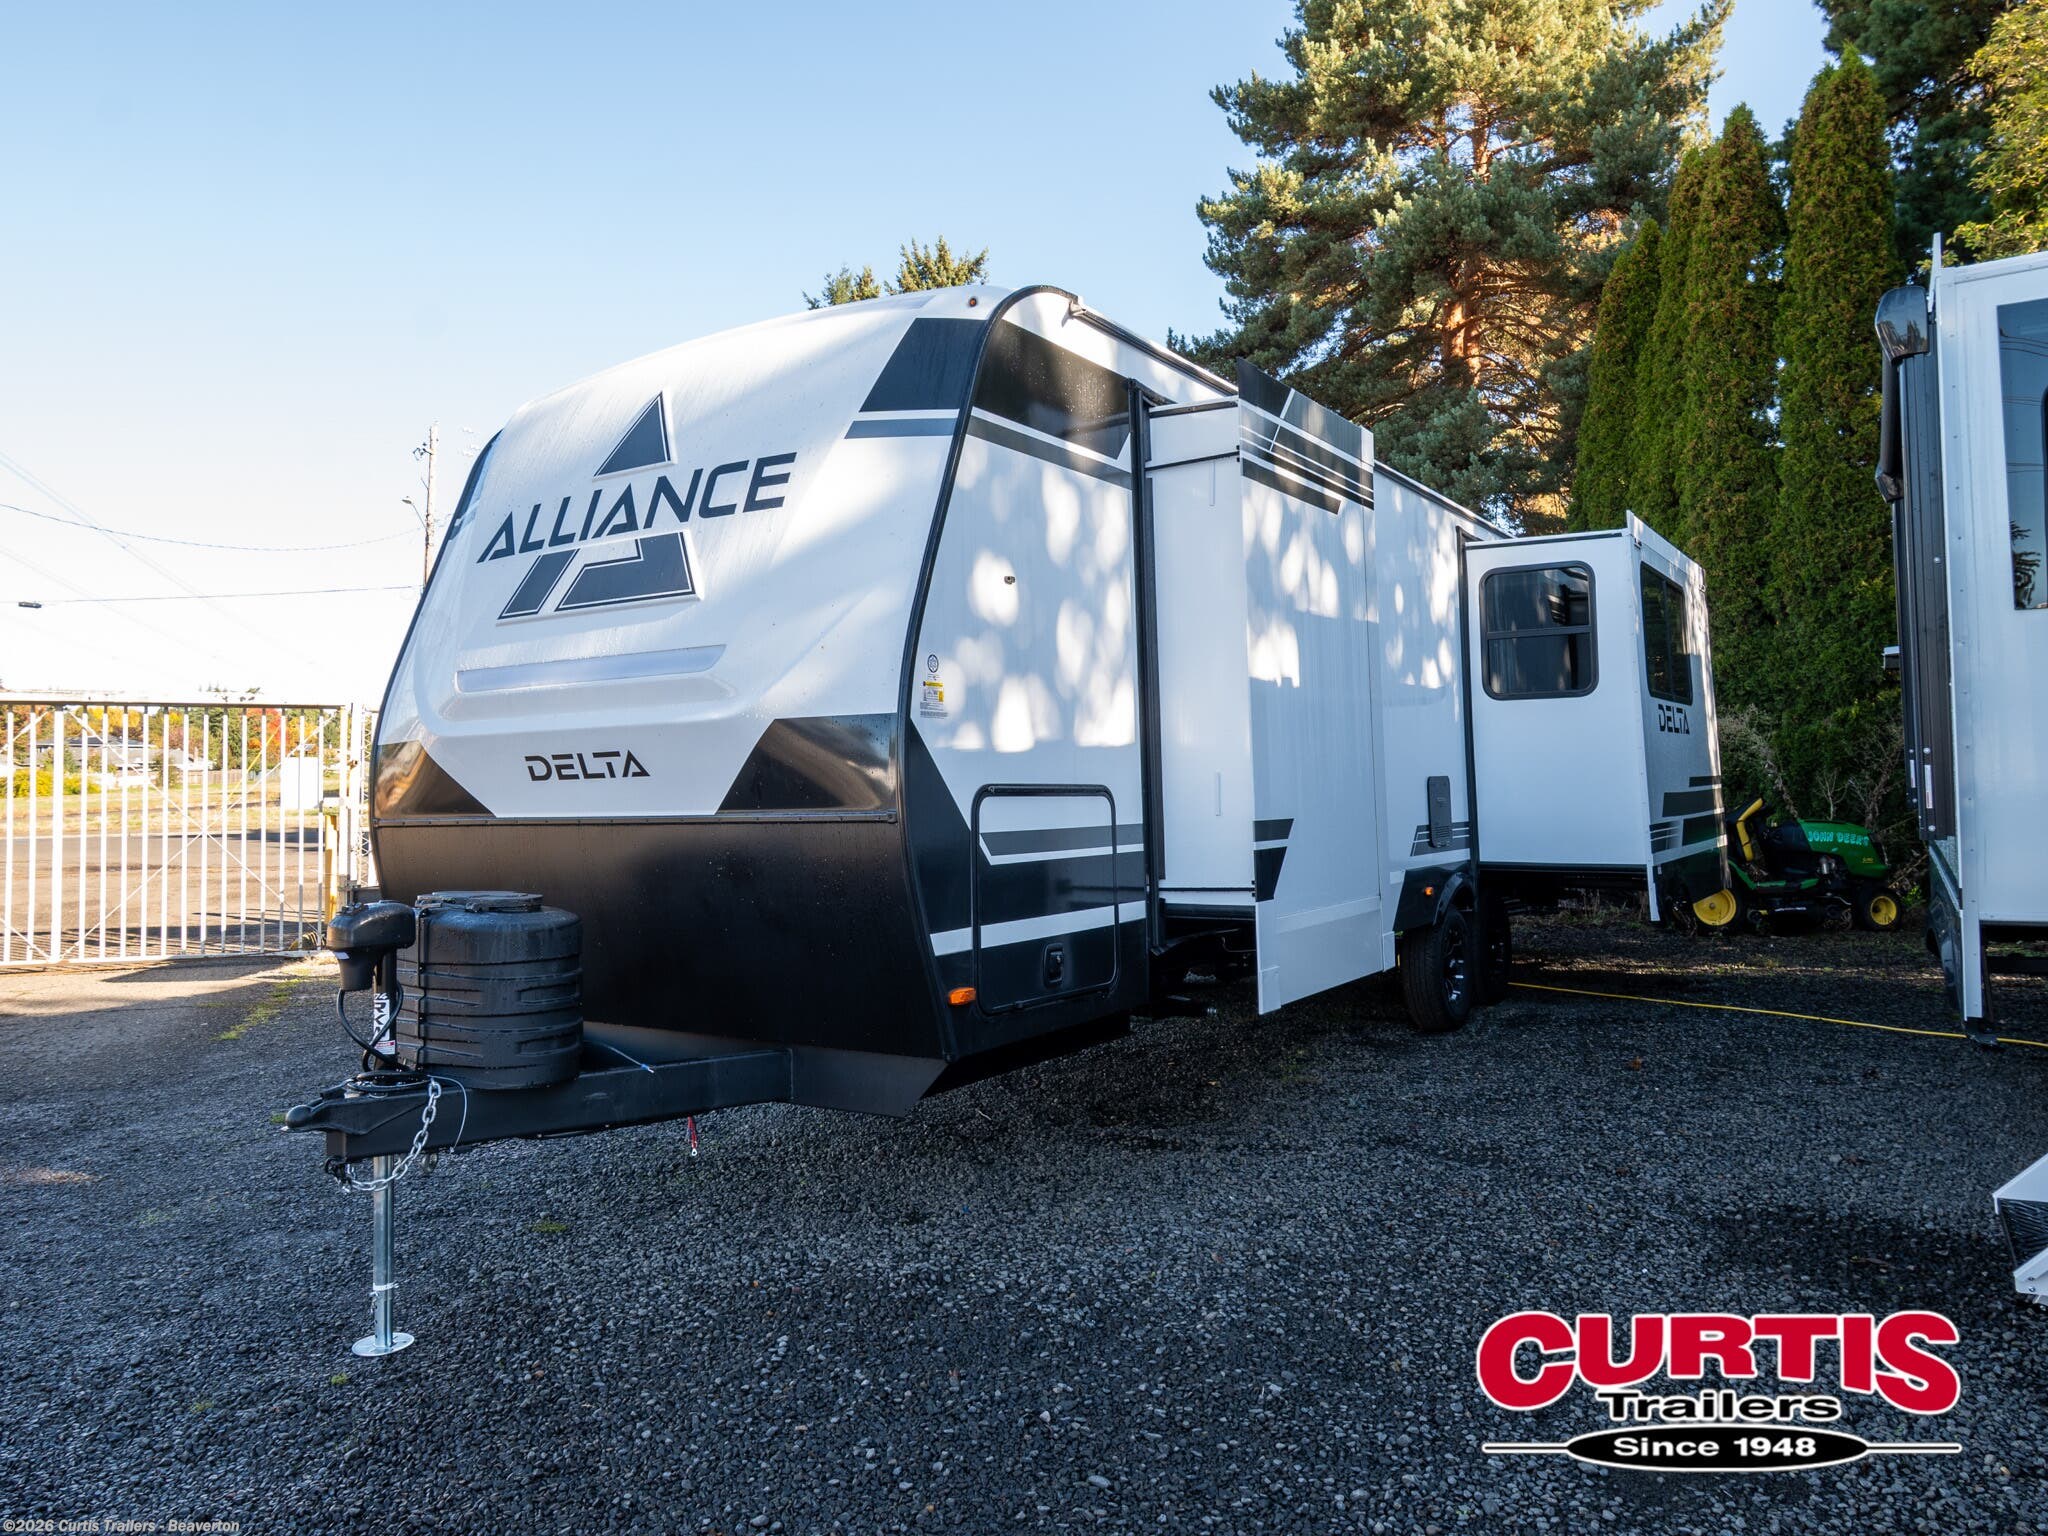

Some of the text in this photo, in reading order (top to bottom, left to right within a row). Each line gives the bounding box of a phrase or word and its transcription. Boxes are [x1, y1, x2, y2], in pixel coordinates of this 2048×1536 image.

[477, 451, 797, 563] ALLIANCE
[1658, 704, 1690, 735] DELTA
[524, 750, 650, 781] DELTA
[1808, 830, 1834, 842] JOHN
